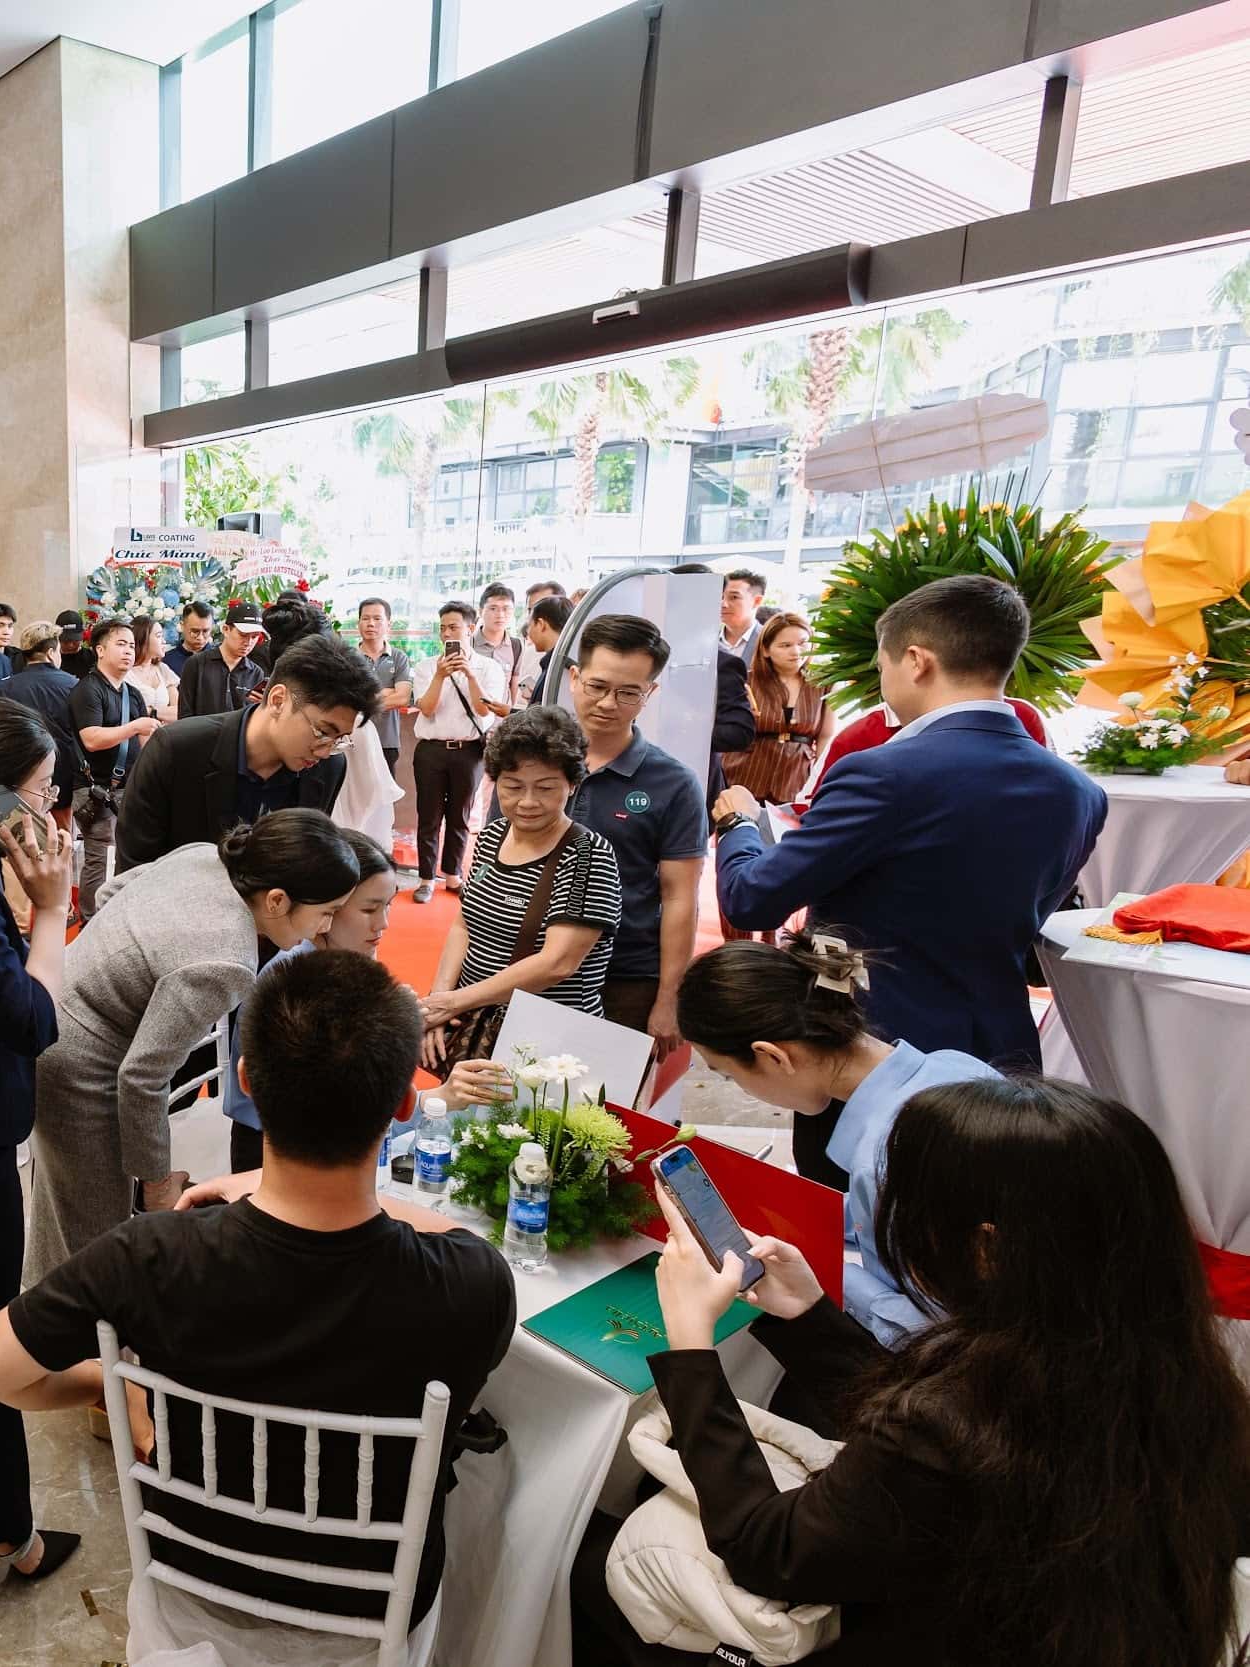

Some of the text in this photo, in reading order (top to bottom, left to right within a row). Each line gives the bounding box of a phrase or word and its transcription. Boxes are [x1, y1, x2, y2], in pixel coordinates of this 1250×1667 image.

[158, 534, 196, 542] COATING
[115, 549, 154, 559] Chúc
[629, 798, 647, 806] 119
